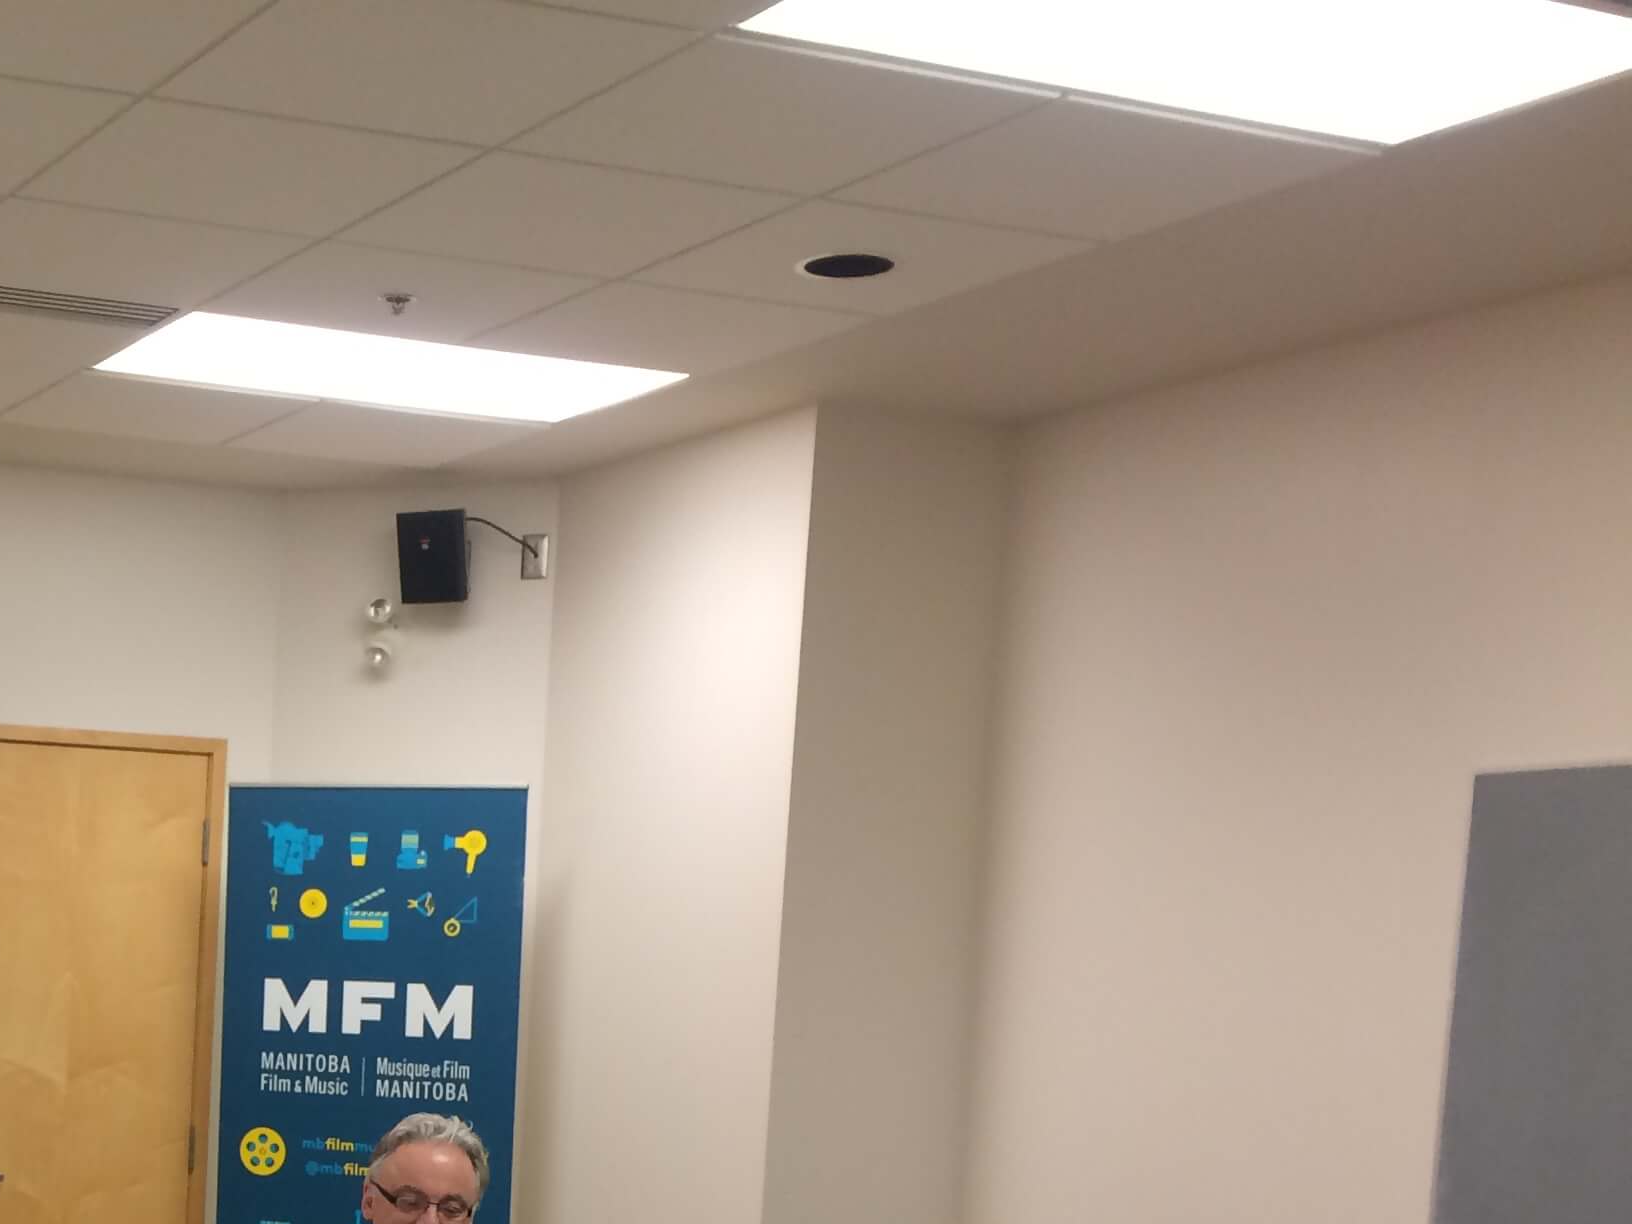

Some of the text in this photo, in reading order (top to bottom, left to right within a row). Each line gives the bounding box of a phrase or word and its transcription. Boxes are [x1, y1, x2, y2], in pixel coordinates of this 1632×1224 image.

[263, 977, 474, 1040] MFM
[260, 1051, 351, 1074] MANITOBA
[376, 1057, 471, 1080] Musique et Film
[260, 1073, 349, 1096] Film & Music
[375, 1079, 469, 1102] MANITOBA
